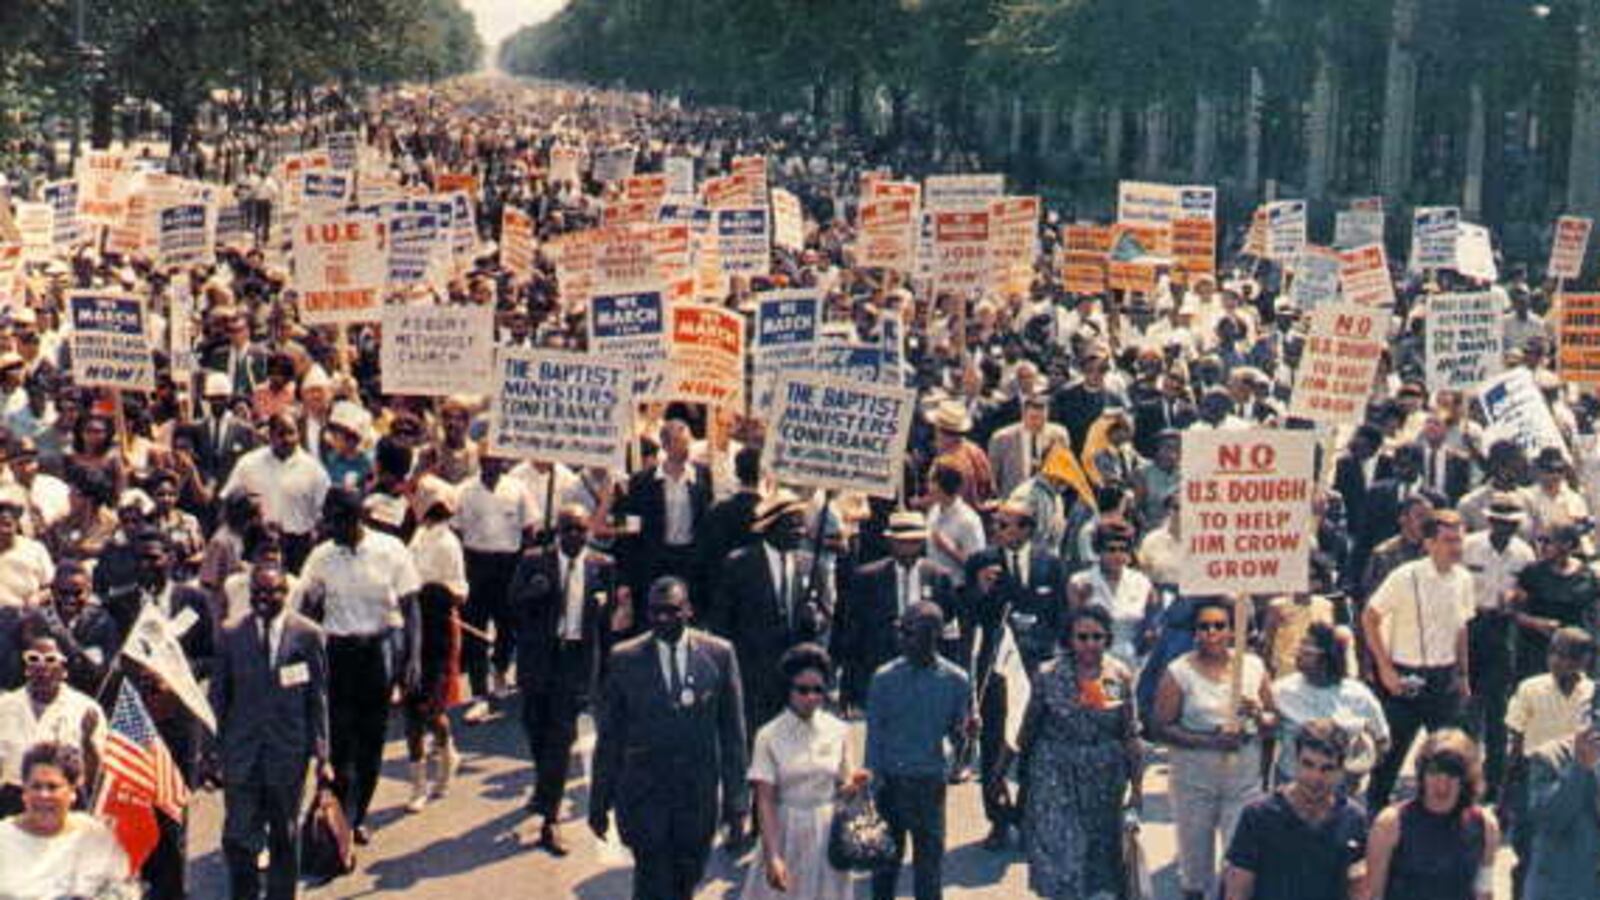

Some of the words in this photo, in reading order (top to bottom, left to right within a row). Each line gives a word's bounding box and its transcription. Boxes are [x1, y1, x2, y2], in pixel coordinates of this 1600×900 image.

[78, 309, 138, 326] MARCH
[597, 308, 658, 325] MARCH
[763, 315, 812, 334] MARCH
[1335, 313, 1371, 337] NO
[677, 320, 738, 346] MARCH
[84, 365, 144, 383] NOW!
[505, 359, 529, 378] THE
[539, 361, 620, 386] BAPTIST
[503, 380, 619, 405] MINISTERS
[679, 380, 739, 400] NOW!
[787, 381, 812, 404] THE
[823, 386, 902, 420] BAPTIST
[783, 404, 899, 435] MINISTERS
[1217, 443, 1275, 469] NO
[1187, 480, 1221, 503] U.S.
[1228, 478, 1307, 503] DOUGH
[1198, 511, 1227, 529] TO
[1235, 510, 1291, 529] HELP
[1191, 535, 1225, 554] JIM
[1234, 532, 1300, 552] CROW
[1207, 558, 1279, 580] GROW
